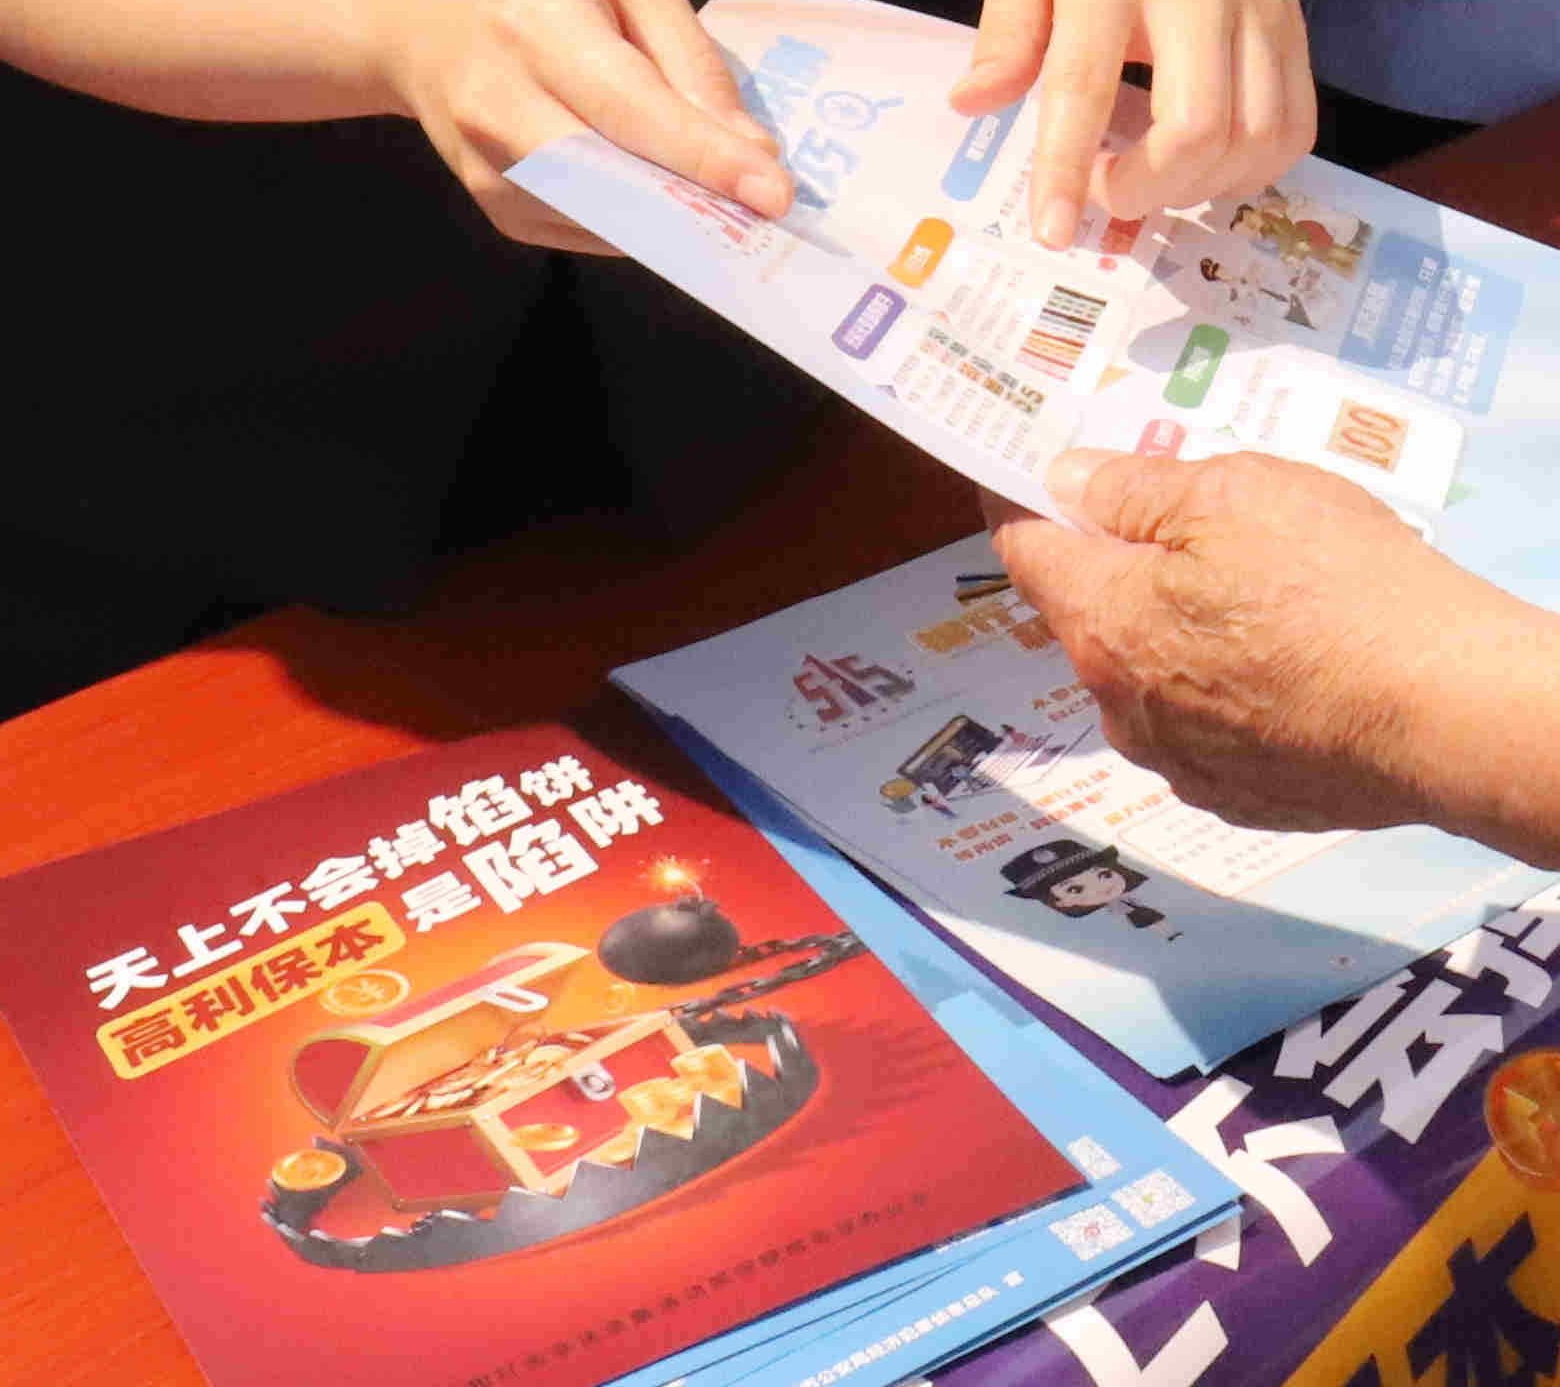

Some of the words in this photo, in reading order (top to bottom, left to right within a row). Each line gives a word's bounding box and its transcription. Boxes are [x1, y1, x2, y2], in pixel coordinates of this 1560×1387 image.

[86, 754, 594, 1010] 天上不会掉馅饼
[107, 917, 386, 1068] 高利保本
[399, 778, 666, 933] 是陷阱
